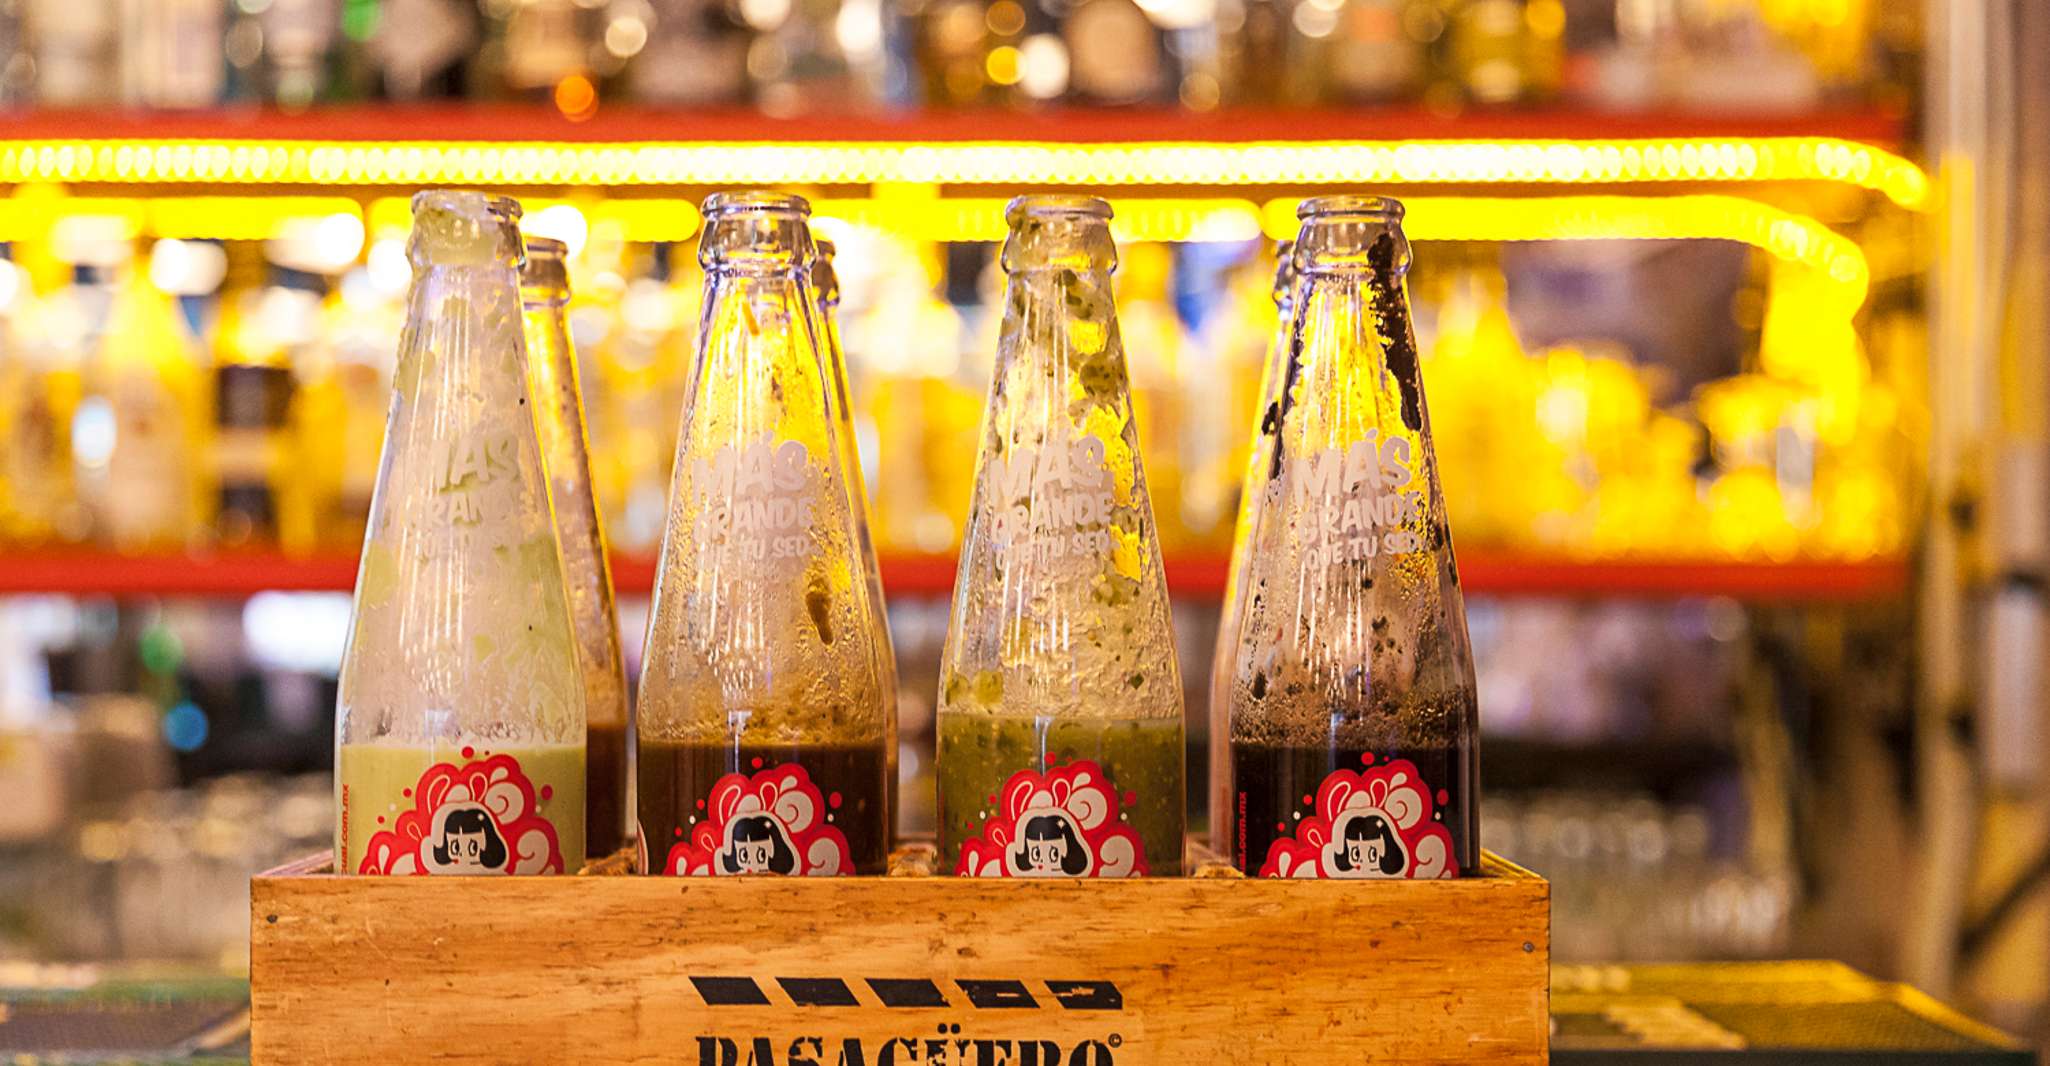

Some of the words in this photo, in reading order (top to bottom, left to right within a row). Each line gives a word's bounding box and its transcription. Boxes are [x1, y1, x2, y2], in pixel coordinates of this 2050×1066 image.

[1293, 428, 1411, 506] MÁS
[1299, 490, 1423, 545] GRANDE
[1348, 536, 1378, 561] TU
